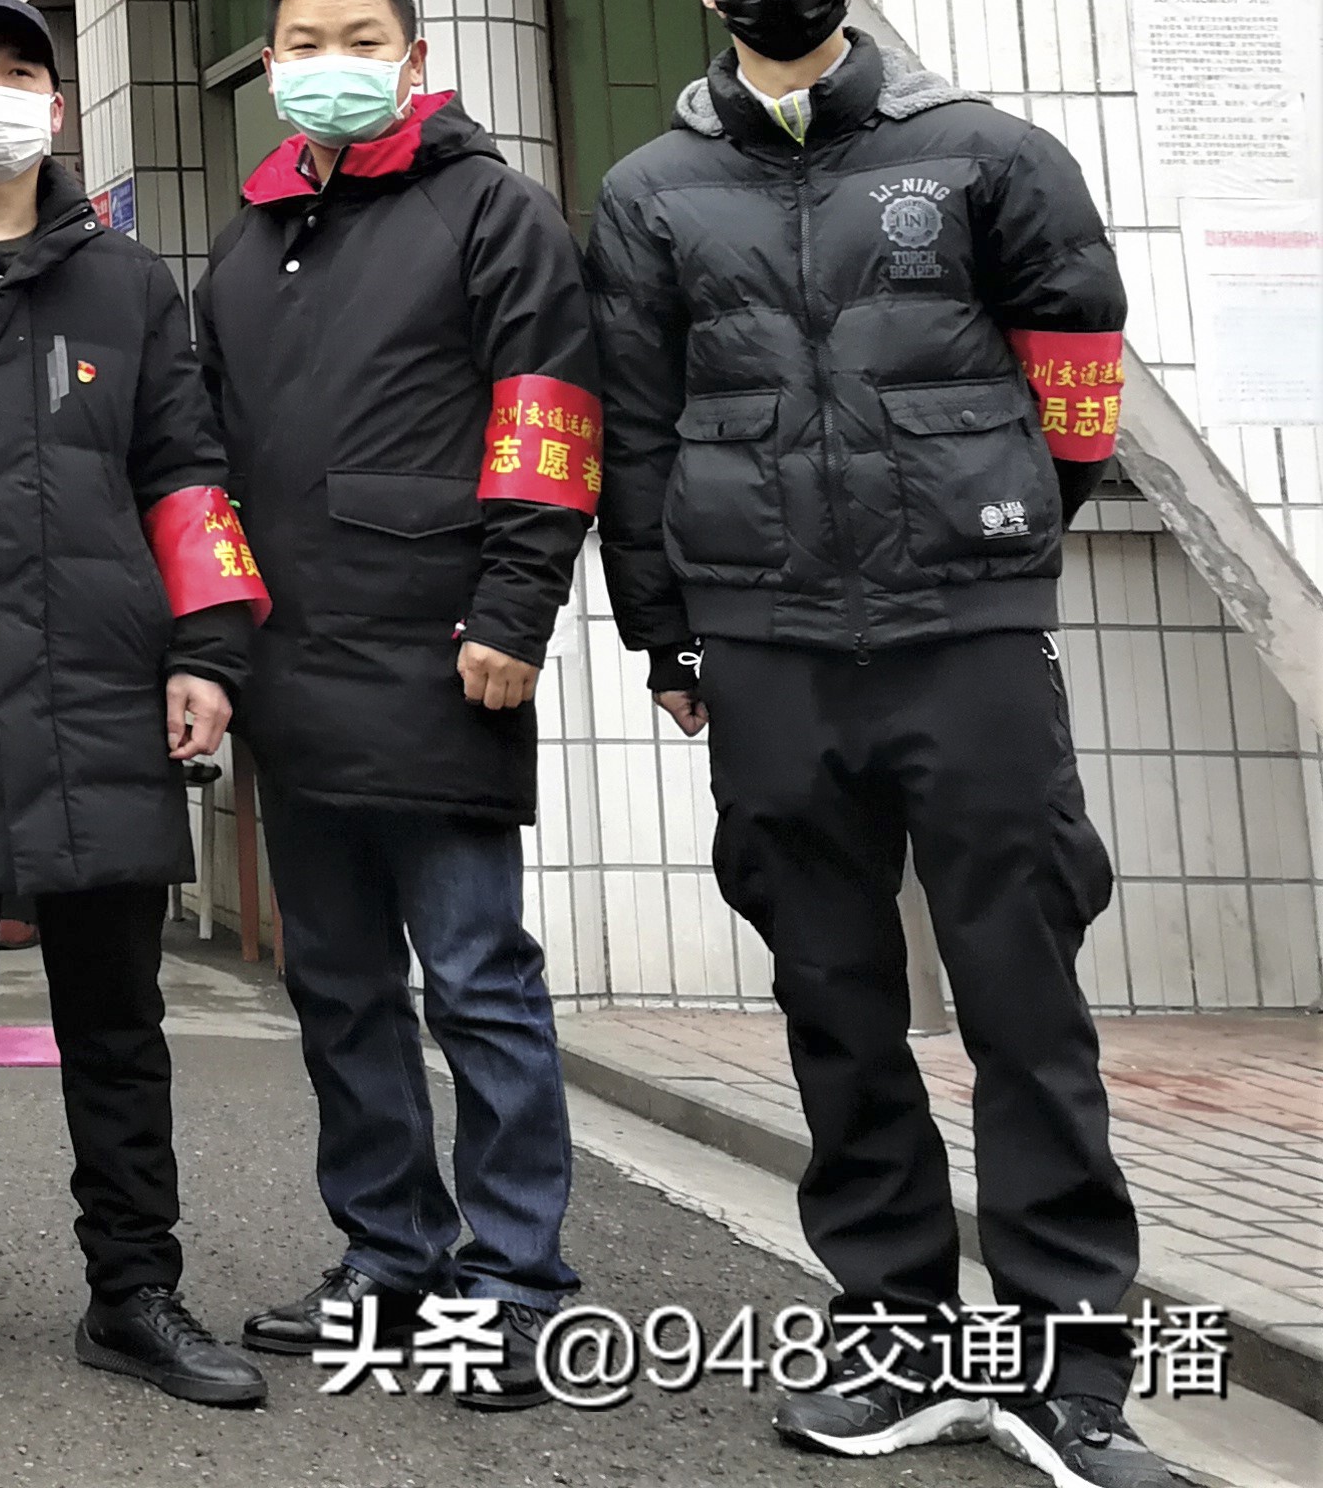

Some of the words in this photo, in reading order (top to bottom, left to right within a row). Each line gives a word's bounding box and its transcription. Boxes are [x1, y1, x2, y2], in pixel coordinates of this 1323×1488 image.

[868, 177, 951, 203] LI-NING
[892, 251, 937, 265] TORCH
[490, 434, 602, 493] 志愿者
[204, 510, 244, 535] 汉川
[213, 539, 262, 578] 党员
